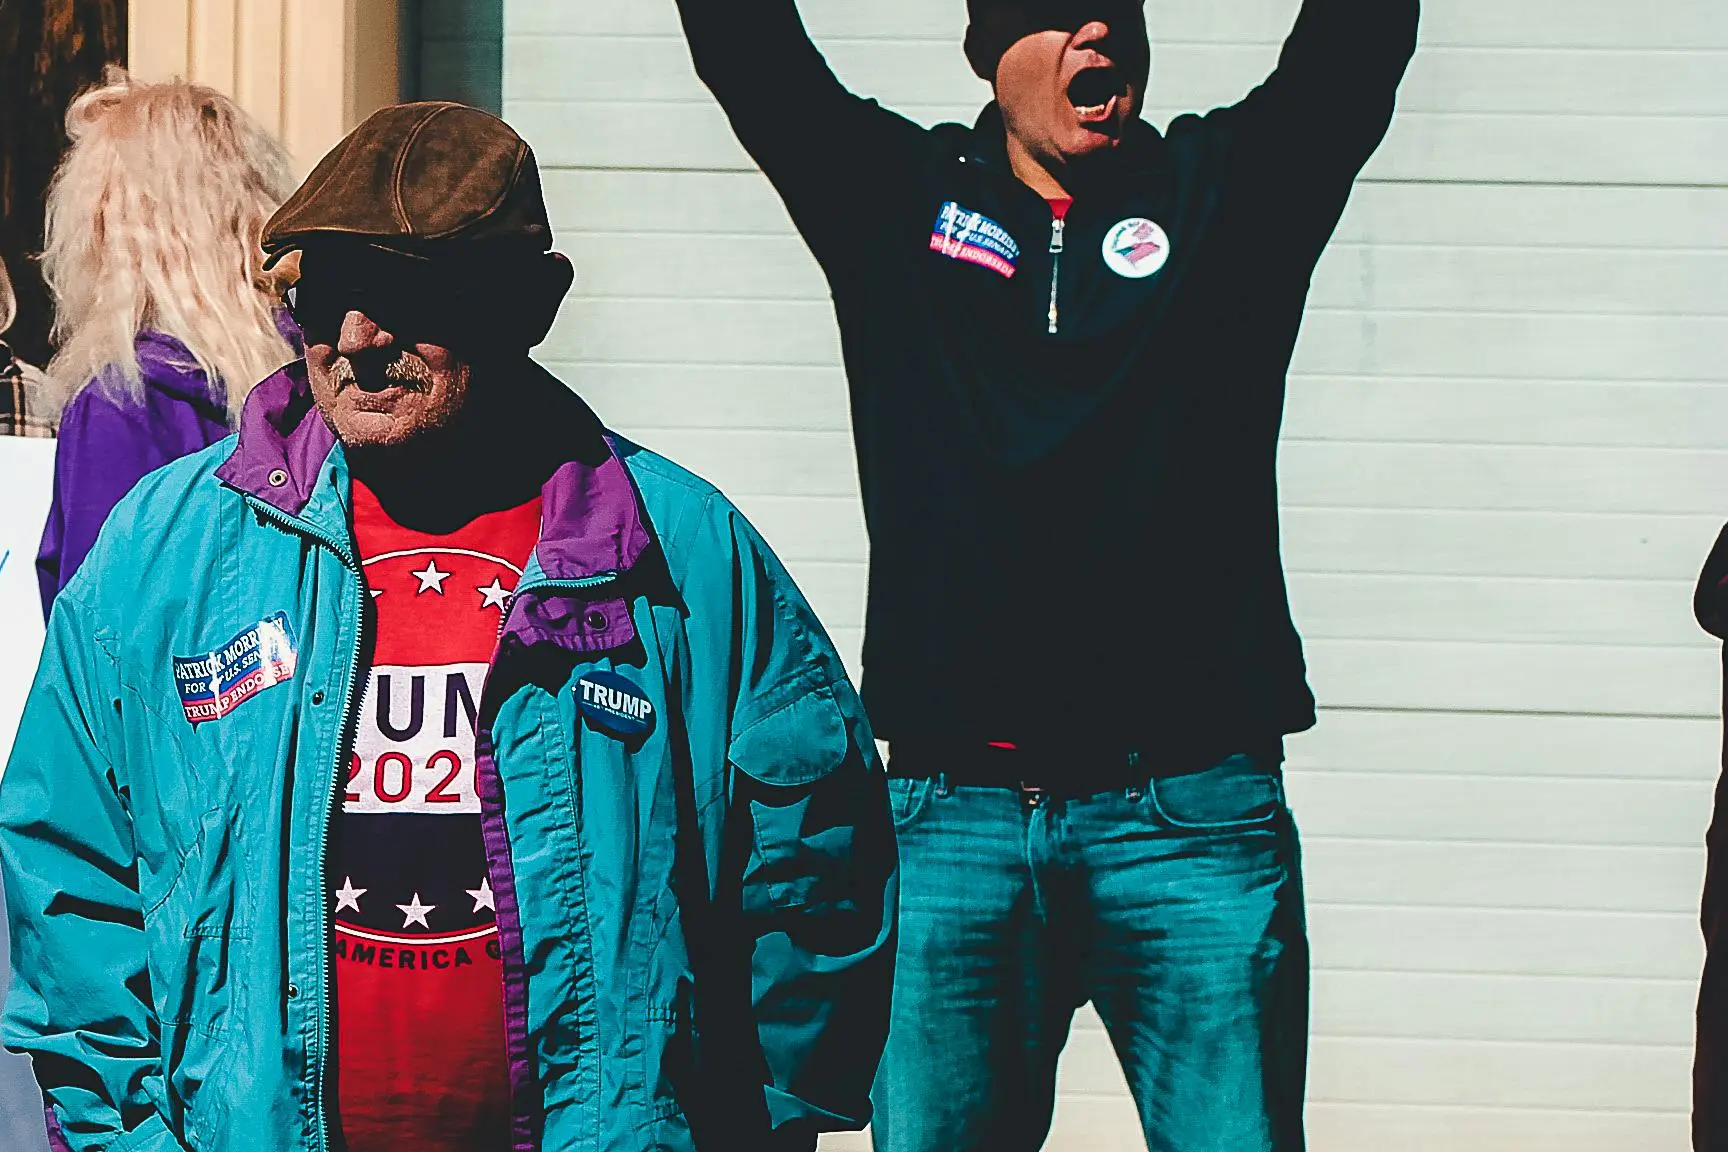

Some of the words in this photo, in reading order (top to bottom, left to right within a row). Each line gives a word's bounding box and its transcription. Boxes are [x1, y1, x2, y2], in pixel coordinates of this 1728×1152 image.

[223, 618, 284, 666] MORRY
[185, 682, 206, 694] FOR
[580, 679, 651, 719] TRUMP
[185, 697, 231, 717] TRUMP
